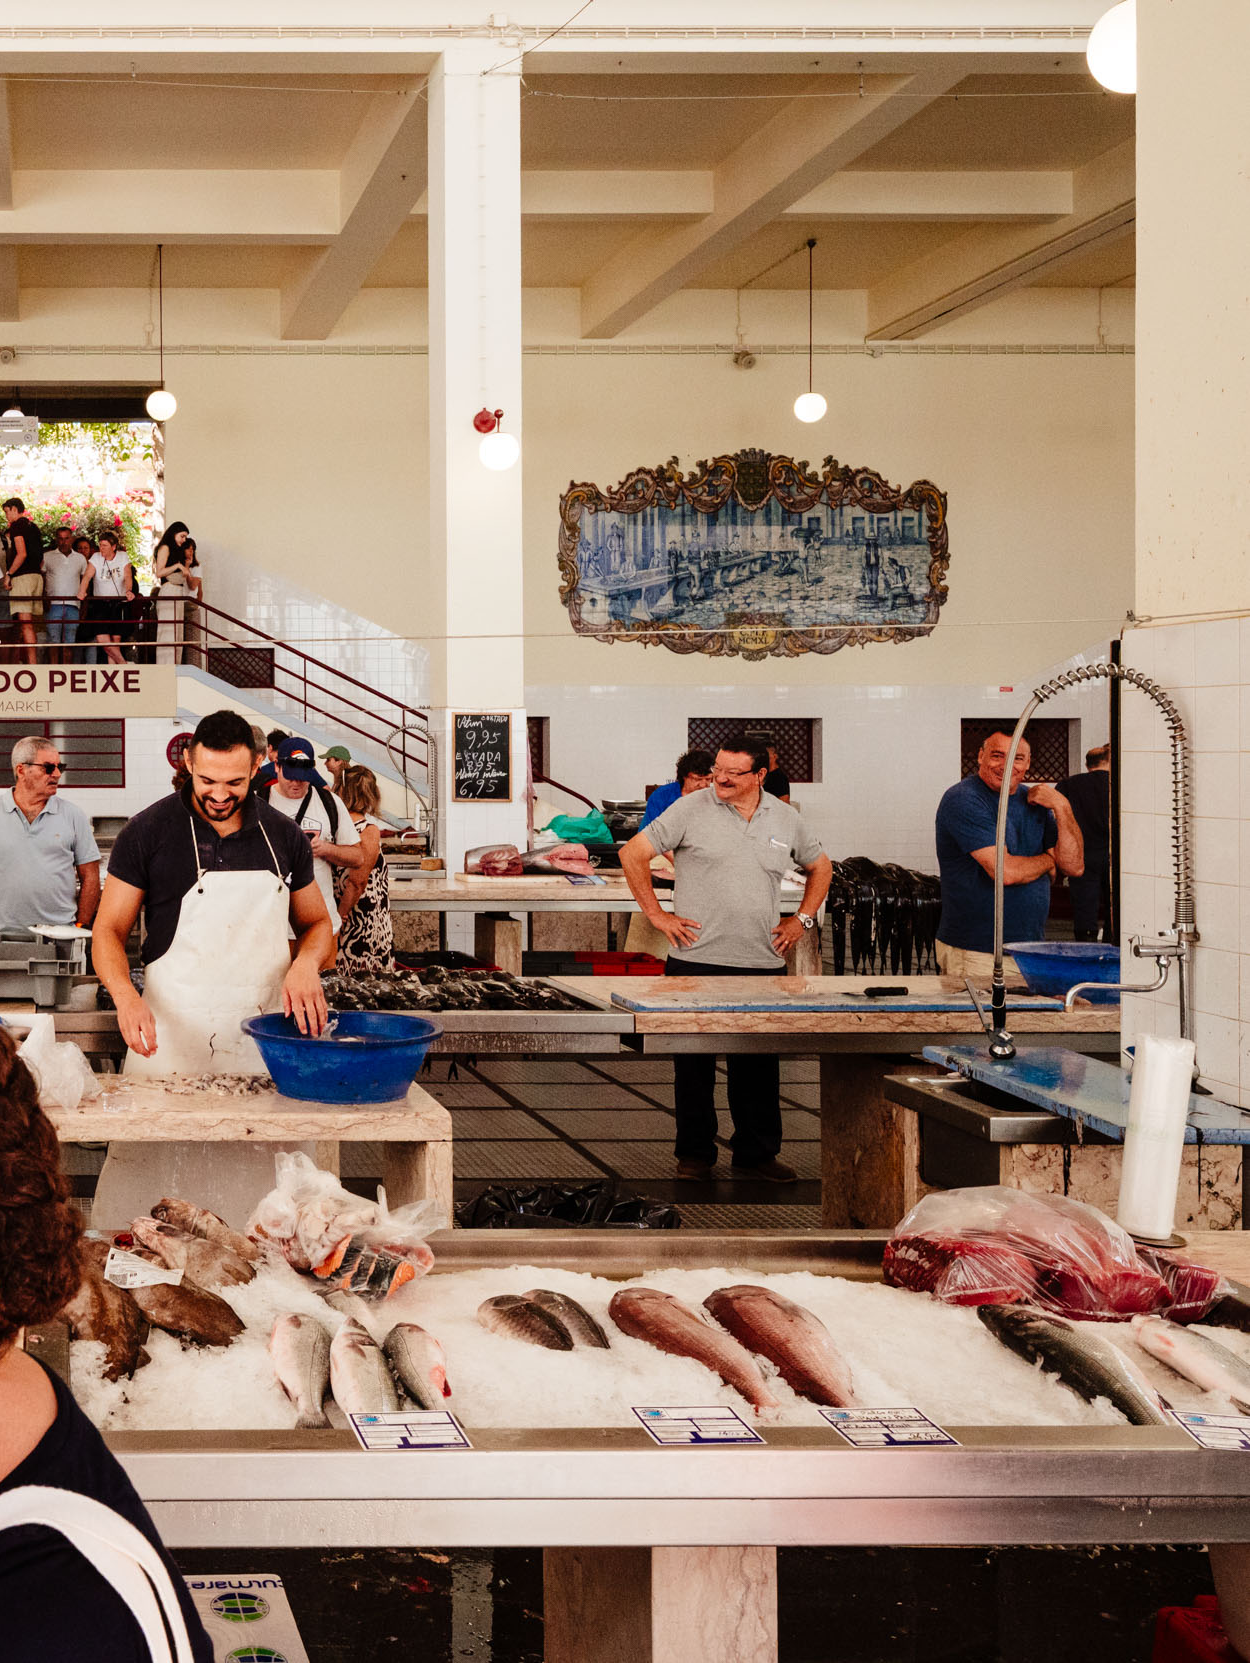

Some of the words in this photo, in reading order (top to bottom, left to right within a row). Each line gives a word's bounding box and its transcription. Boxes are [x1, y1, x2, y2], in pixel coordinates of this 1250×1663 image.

[739, 637, 769, 645] MCMXL
[49, 669, 141, 693] PEIXE
[466, 730, 501, 750] 9,95
[460, 779, 498, 799] 6,95
